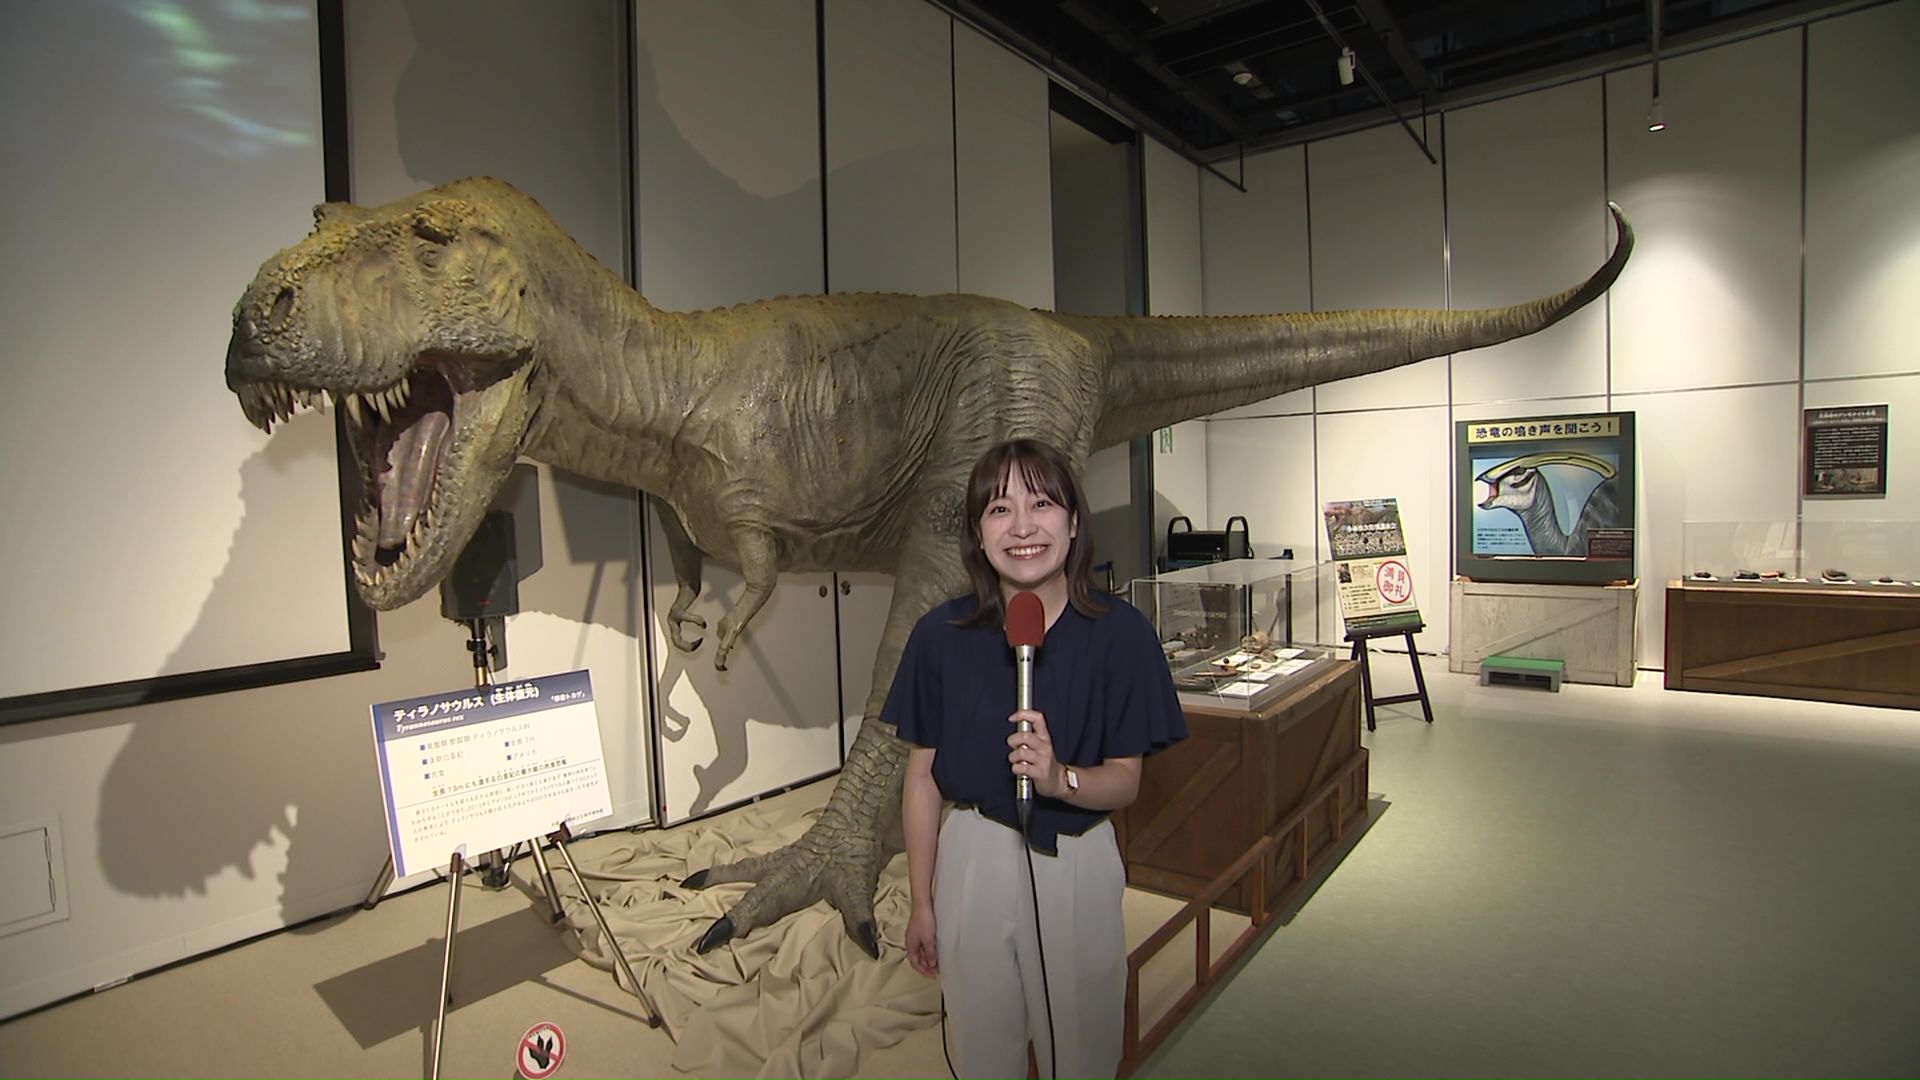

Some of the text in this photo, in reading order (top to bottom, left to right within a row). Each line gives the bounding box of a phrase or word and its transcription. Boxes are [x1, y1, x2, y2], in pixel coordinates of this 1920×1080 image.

[1475, 421, 1612, 439] 恐竜の鳴き声を聞こう！
[393, 696, 485, 722] ティラノサウルス
